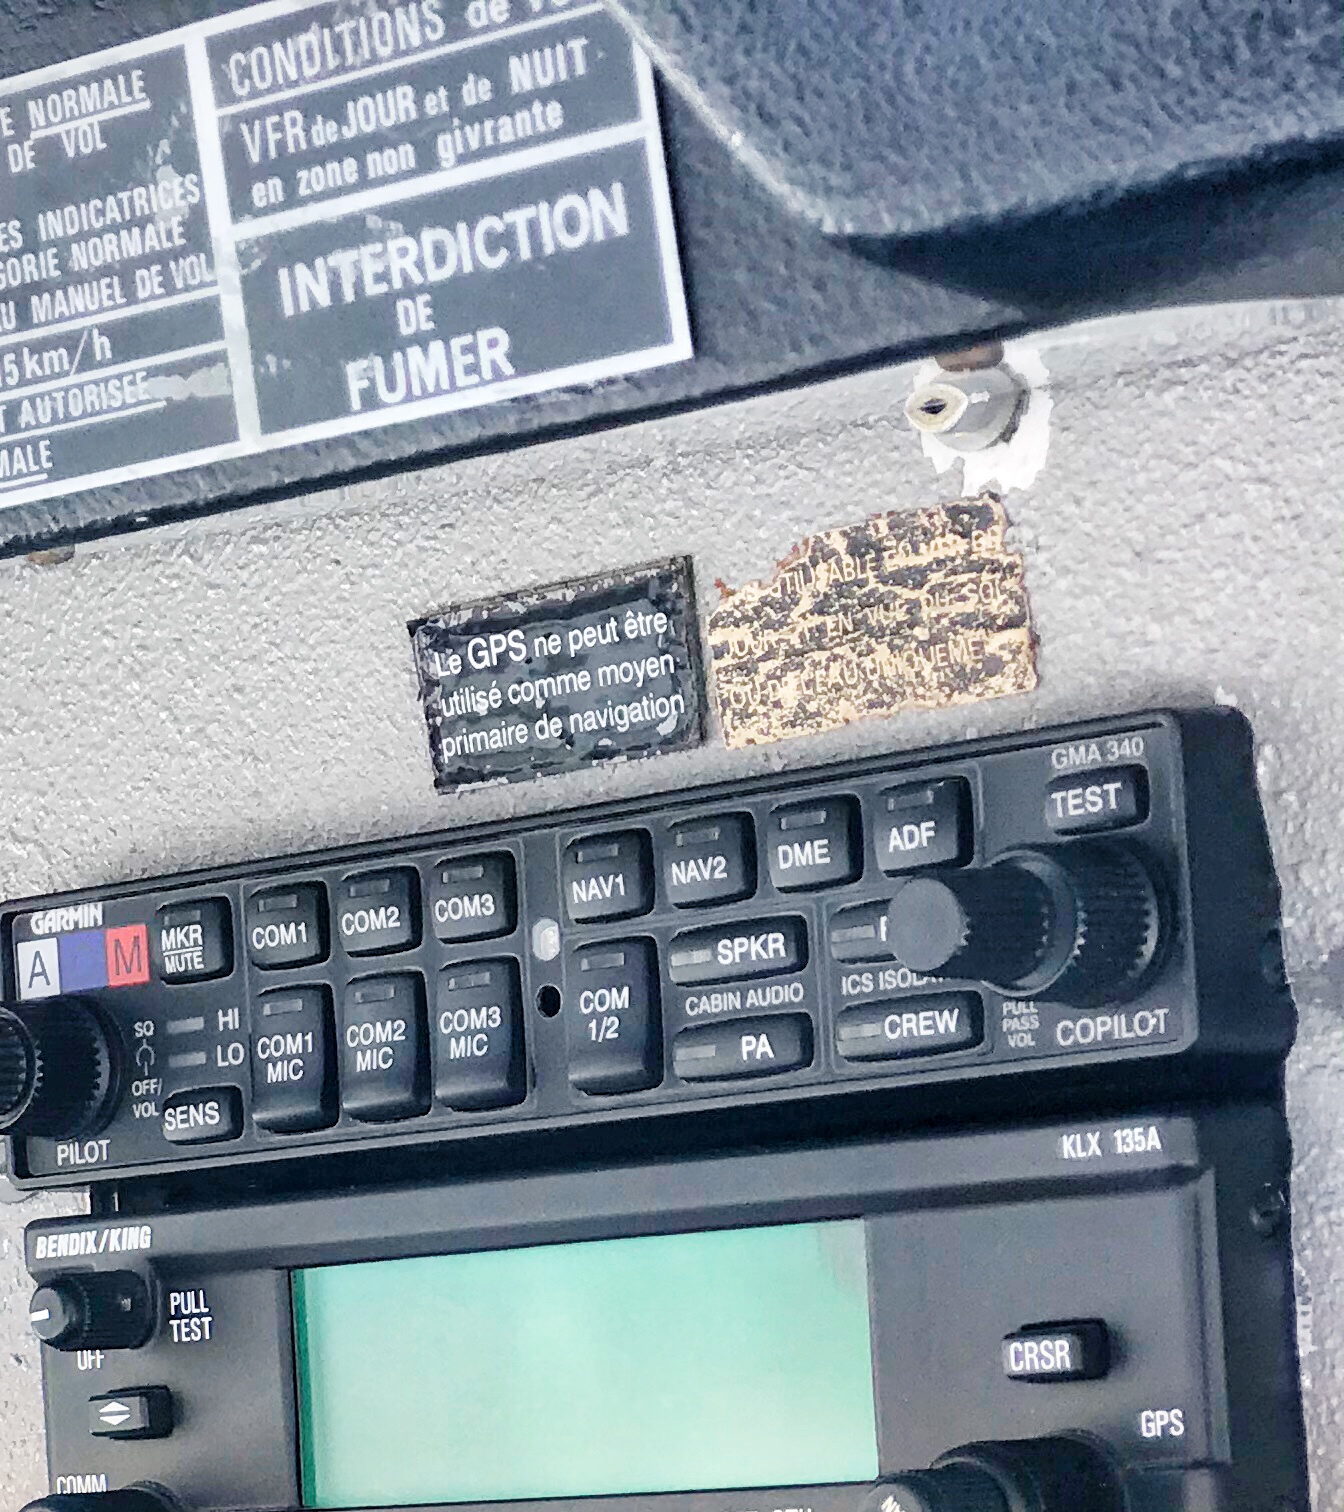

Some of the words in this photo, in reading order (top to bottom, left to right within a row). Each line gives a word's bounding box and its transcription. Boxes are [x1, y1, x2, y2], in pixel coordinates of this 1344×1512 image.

[227, 3, 446, 96] CONDITIONS
[28, 70, 147, 128] NORMALE
[239, 110, 308, 164] VFR
[311, 115, 340, 147] de
[342, 84, 417, 139] JOUR
[424, 84, 450, 116] et
[461, 73, 493, 107] de
[508, 37, 589, 94] NUIT
[251, 177, 284, 208] en
[297, 156, 358, 197] zone
[366, 143, 416, 179] non
[437, 99, 564, 168] givrante
[277, 182, 630, 318] INTERDICTION
[396, 294, 435, 337] DE
[346, 326, 515, 411] FUMER
[434, 651, 462, 677] Le
[467, 629, 527, 670] GPS
[534, 634, 562, 657] ne
[568, 617, 620, 657] peut
[624, 611, 667, 639] être
[441, 681, 502, 717] utilisé
[508, 670, 591, 705] comme
[599, 654, 674, 688] moyen
[442, 721, 529, 763] primaire
[535, 714, 562, 740] de
[569, 692, 685, 732] navigation
[1051, 744, 1101, 770] GMA
[1107, 737, 1144, 762] 340
[1051, 782, 1123, 818] TEST
[888, 821, 936, 852] ADF
[777, 839, 830, 869] DME
[671, 856, 727, 885] NAV2
[572, 874, 625, 903] NAV1
[30, 902, 103, 935] GARMIN
[341, 906, 400, 936] COM2
[434, 894, 495, 922] COM3
[161, 924, 203, 950] MKR
[252, 922, 308, 950] COM1
[717, 932, 786, 965] SPKR
[164, 952, 204, 973] MUTE
[579, 986, 629, 1014] COM
[685, 993, 741, 1017] CABIN
[745, 982, 804, 1008] AUDIO
[218, 1008, 240, 1031] HI
[588, 1015, 619, 1042] 1/2
[884, 1009, 960, 1040] CREW
[1056, 1008, 1170, 1046] COPILOT
[257, 1032, 313, 1060] COM1
[741, 1034, 775, 1061] PA
[267, 1059, 304, 1084] MIC
[164, 1101, 220, 1131] SENS
[56, 1139, 111, 1166] PILOT
[1062, 1131, 1102, 1160] KLX
[1114, 1126, 1162, 1155] 135A
[36, 1226, 152, 1259] BENDIX/KING
[170, 1290, 209, 1315] PULL
[170, 1317, 213, 1343] TEST
[1009, 1340, 1071, 1372] CRSR
[1141, 1409, 1185, 1437] GPS
